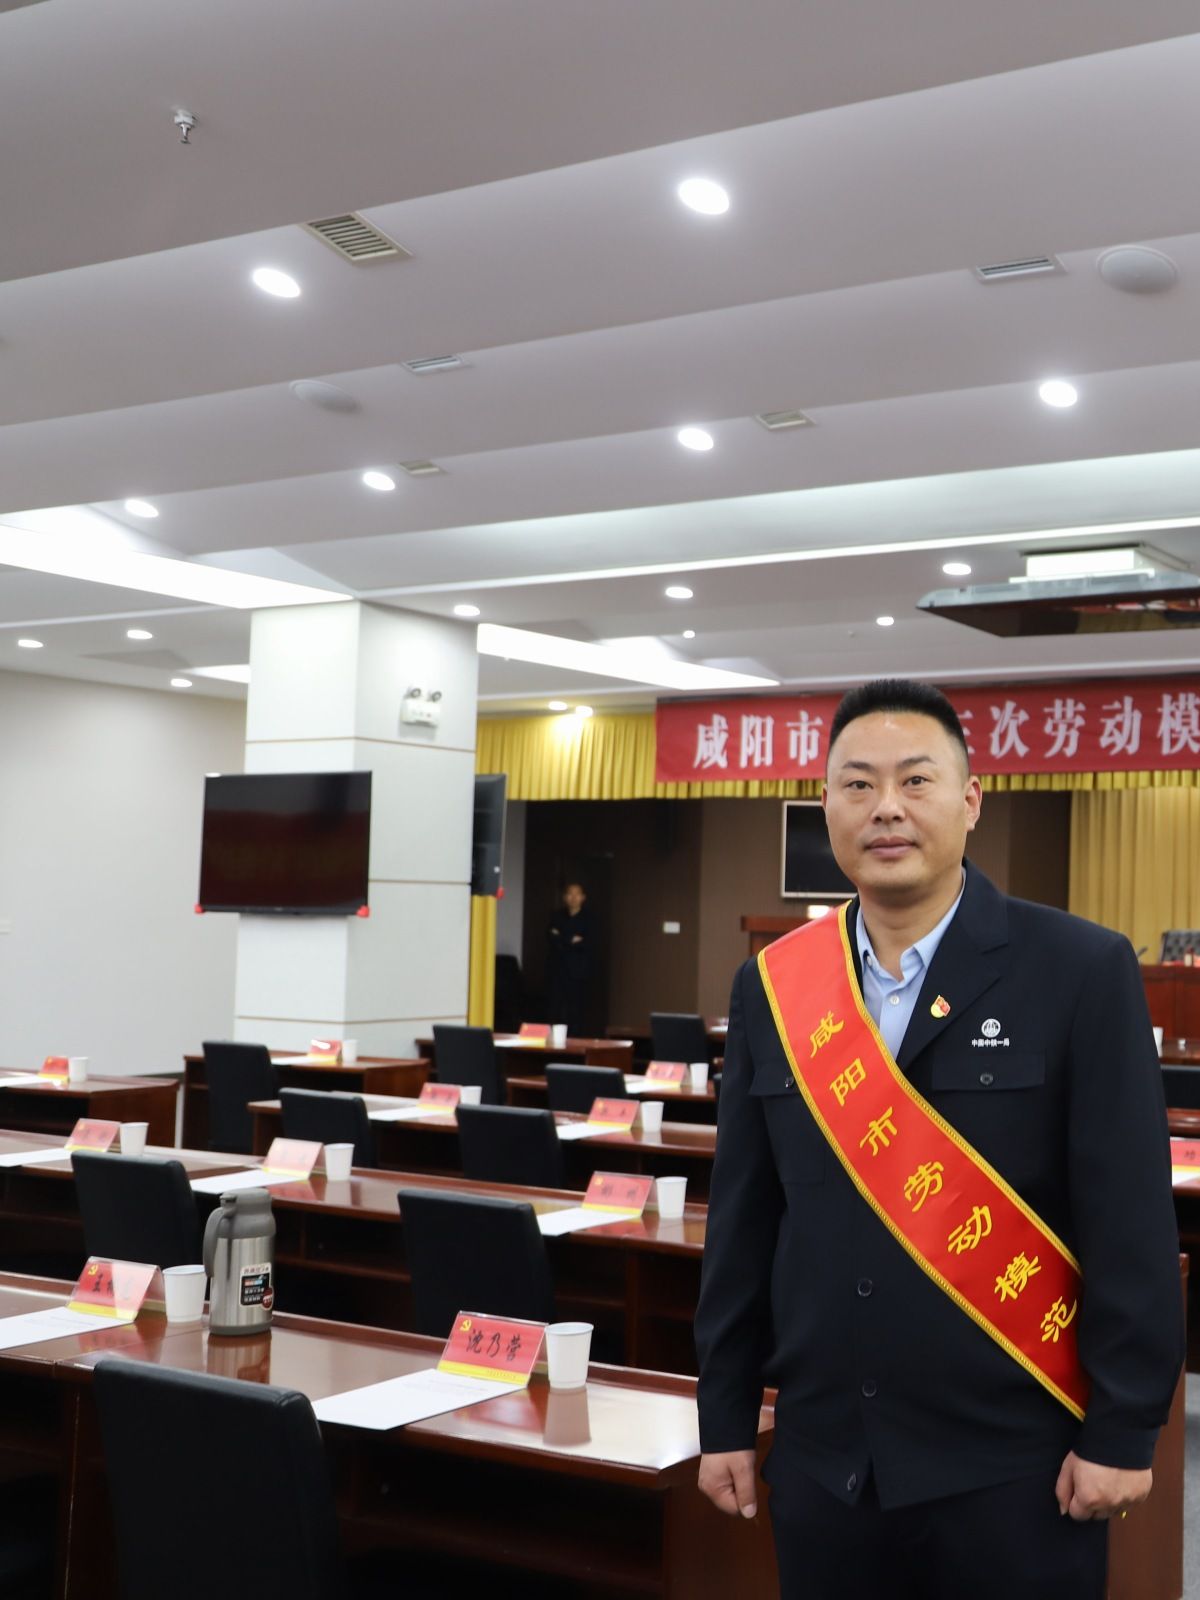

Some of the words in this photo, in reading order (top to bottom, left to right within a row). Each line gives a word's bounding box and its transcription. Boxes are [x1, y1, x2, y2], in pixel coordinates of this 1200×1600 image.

[810, 1010, 1078, 1343] 咸阳市劳动模范
